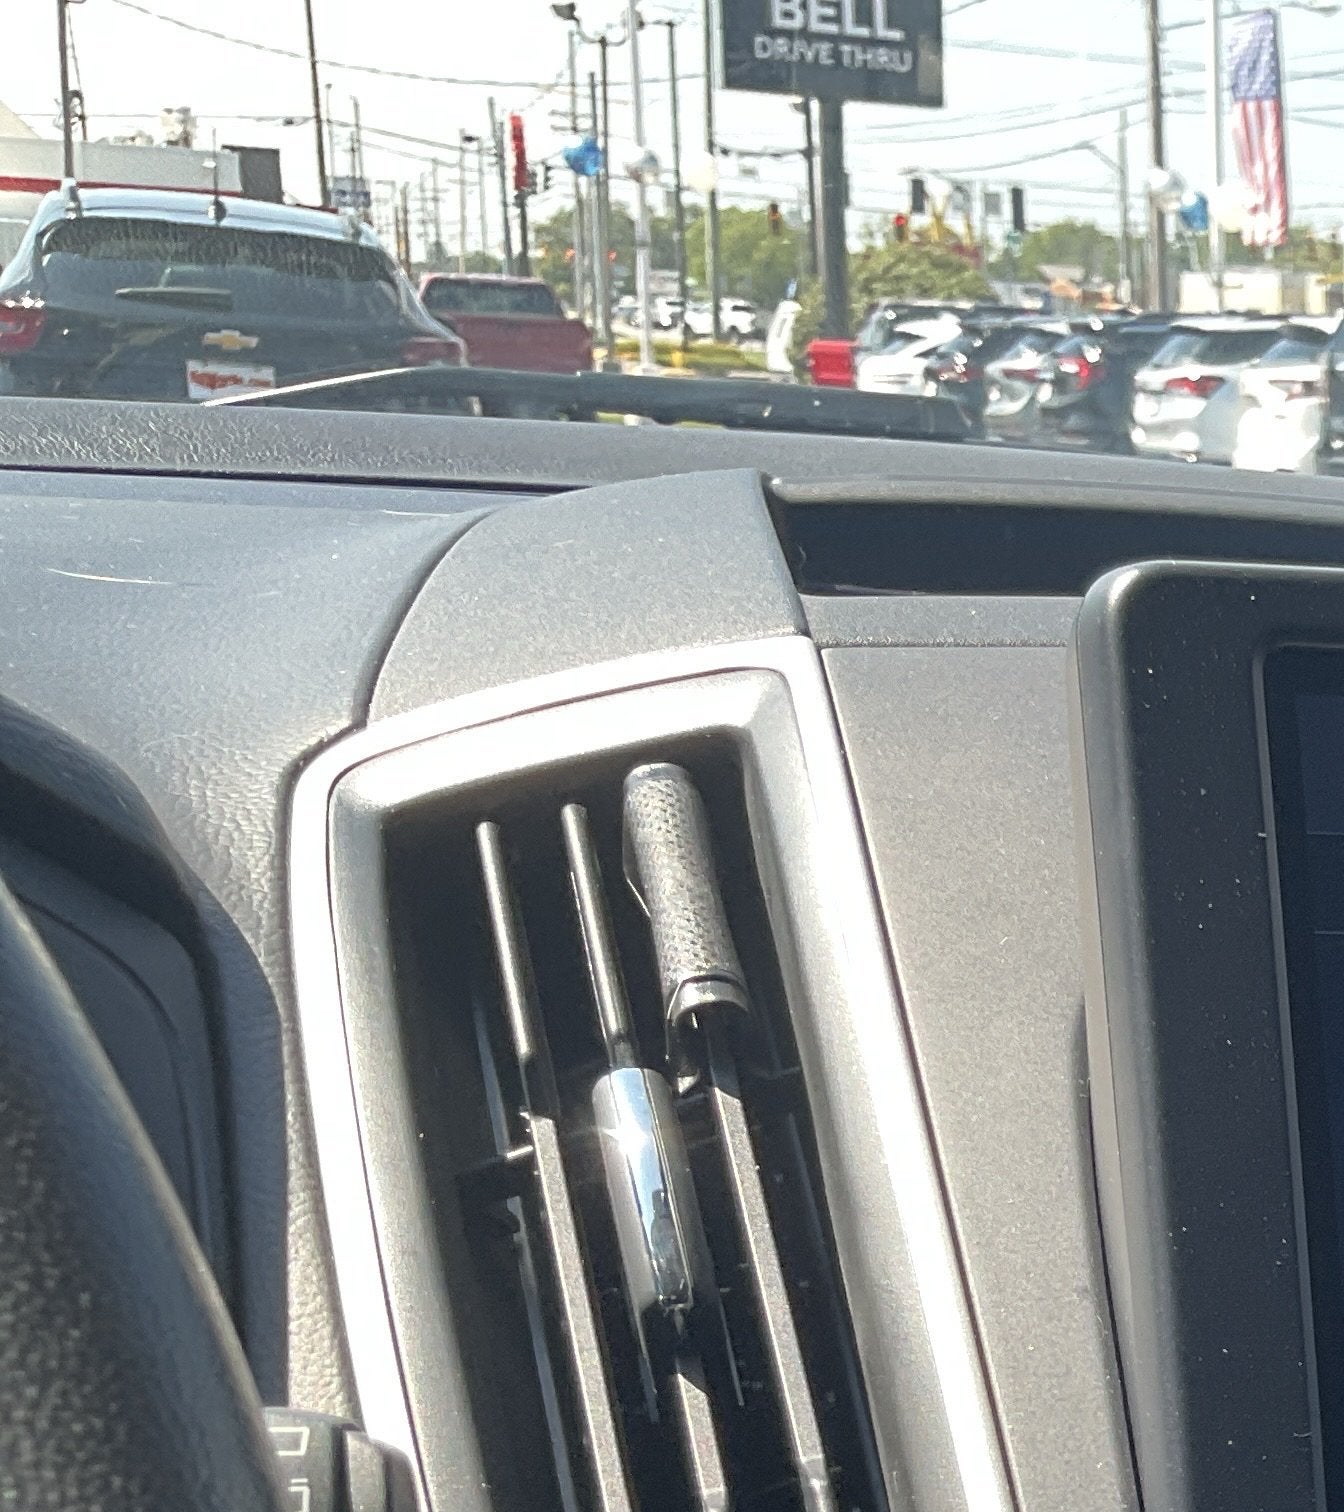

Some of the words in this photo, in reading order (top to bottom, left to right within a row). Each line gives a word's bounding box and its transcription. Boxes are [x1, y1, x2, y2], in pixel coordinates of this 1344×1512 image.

[771, 0, 906, 41] BELL
[753, 34, 835, 65] DRIVE
[838, 43, 913, 74] THRU
